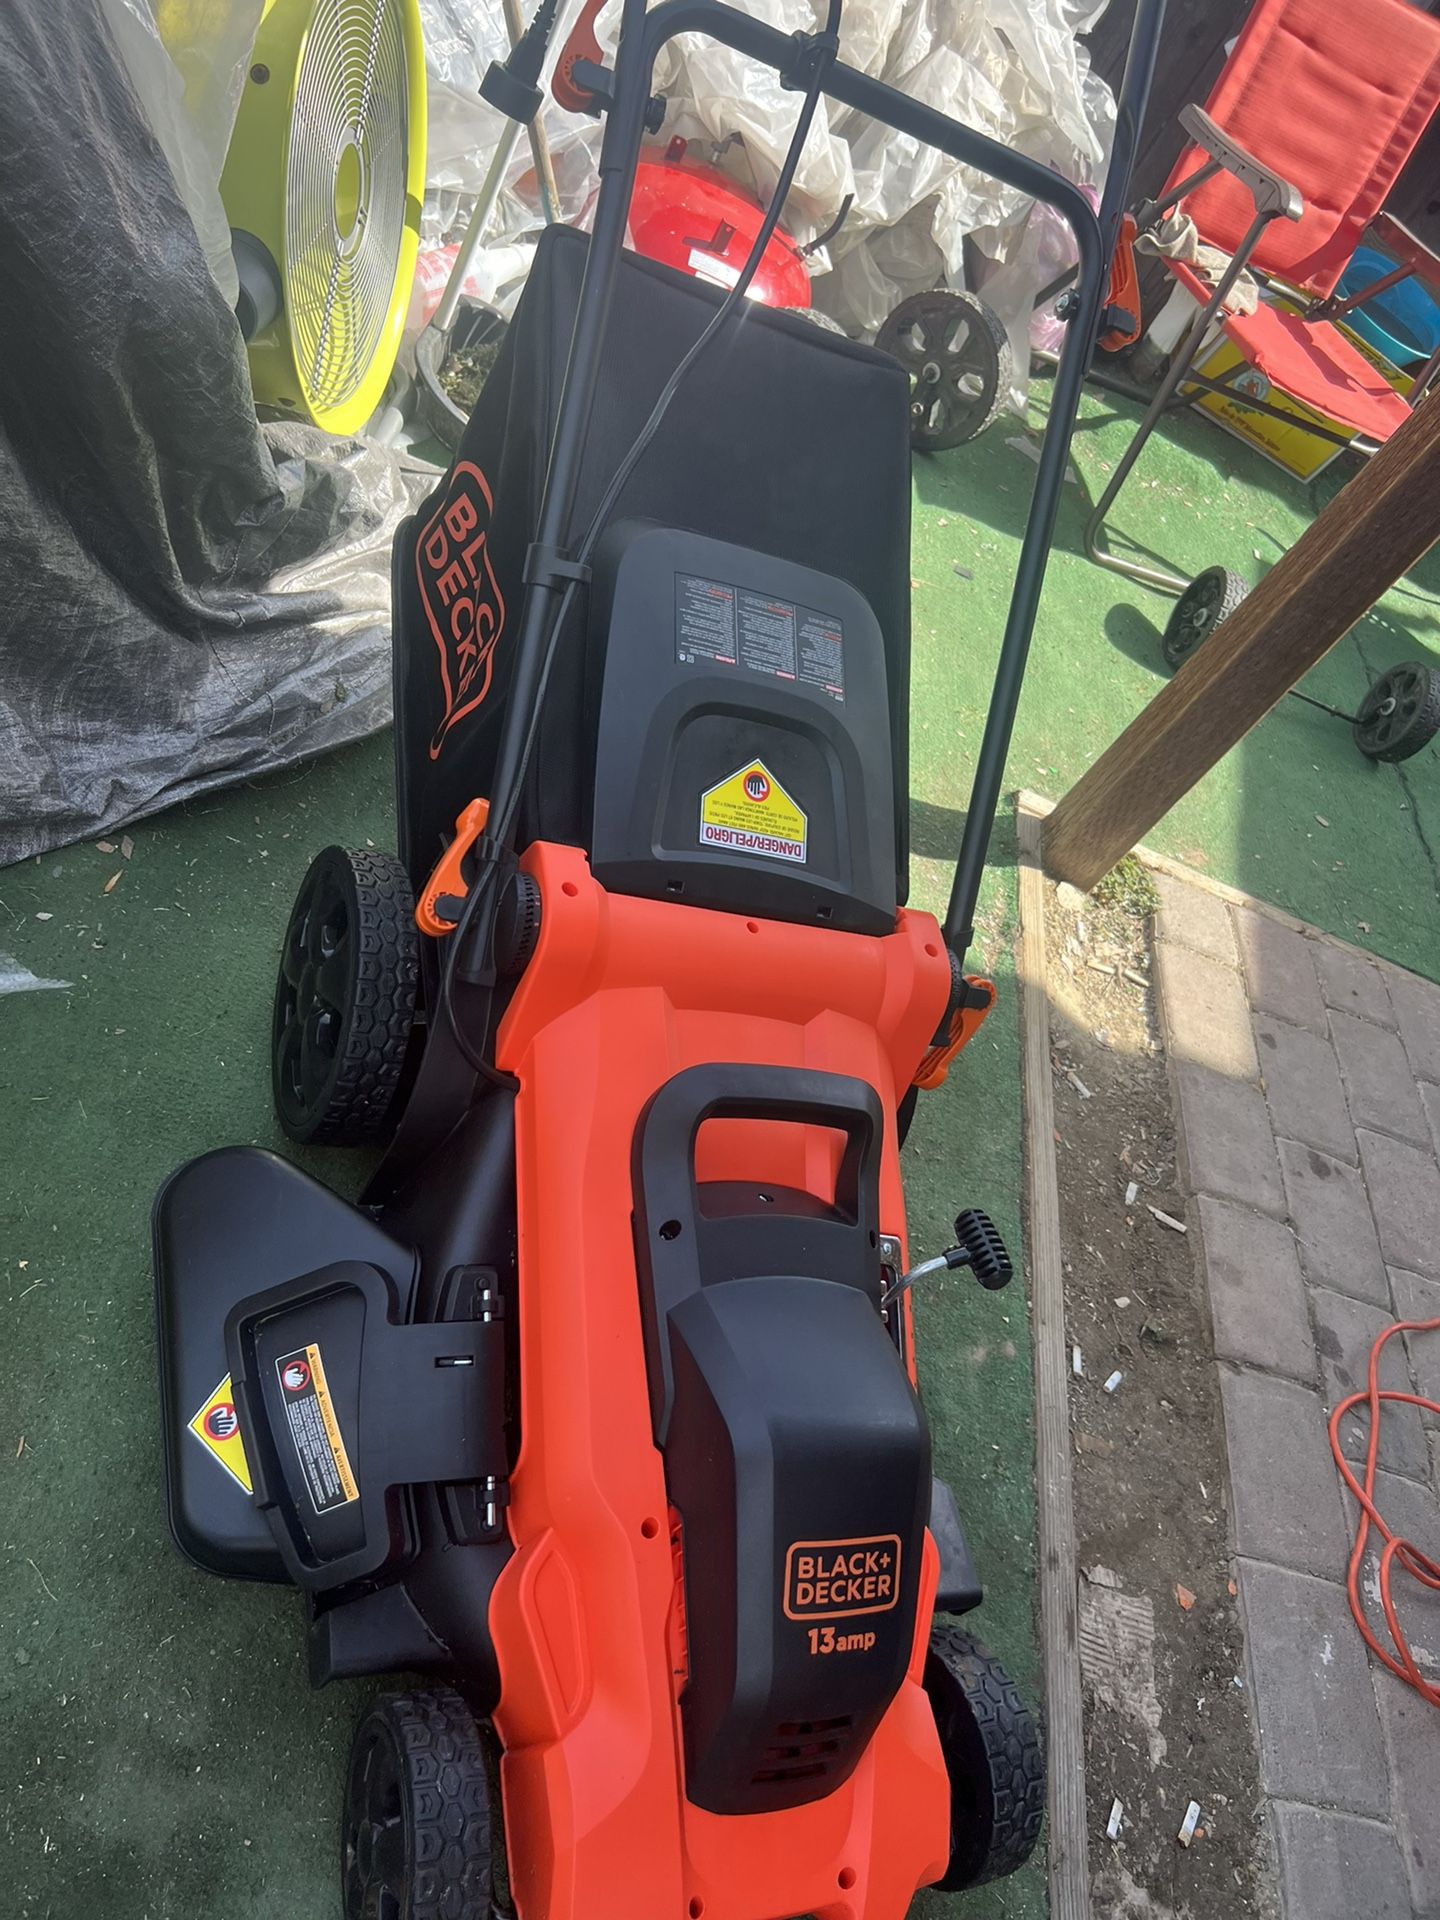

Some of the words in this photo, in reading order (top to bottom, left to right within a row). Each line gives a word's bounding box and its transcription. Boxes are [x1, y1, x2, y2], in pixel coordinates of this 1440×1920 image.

[705, 826, 802, 857] DANGER/PELIGRO
[798, 1551, 890, 1579] BLACK+
[796, 1575, 890, 1605] DECKER
